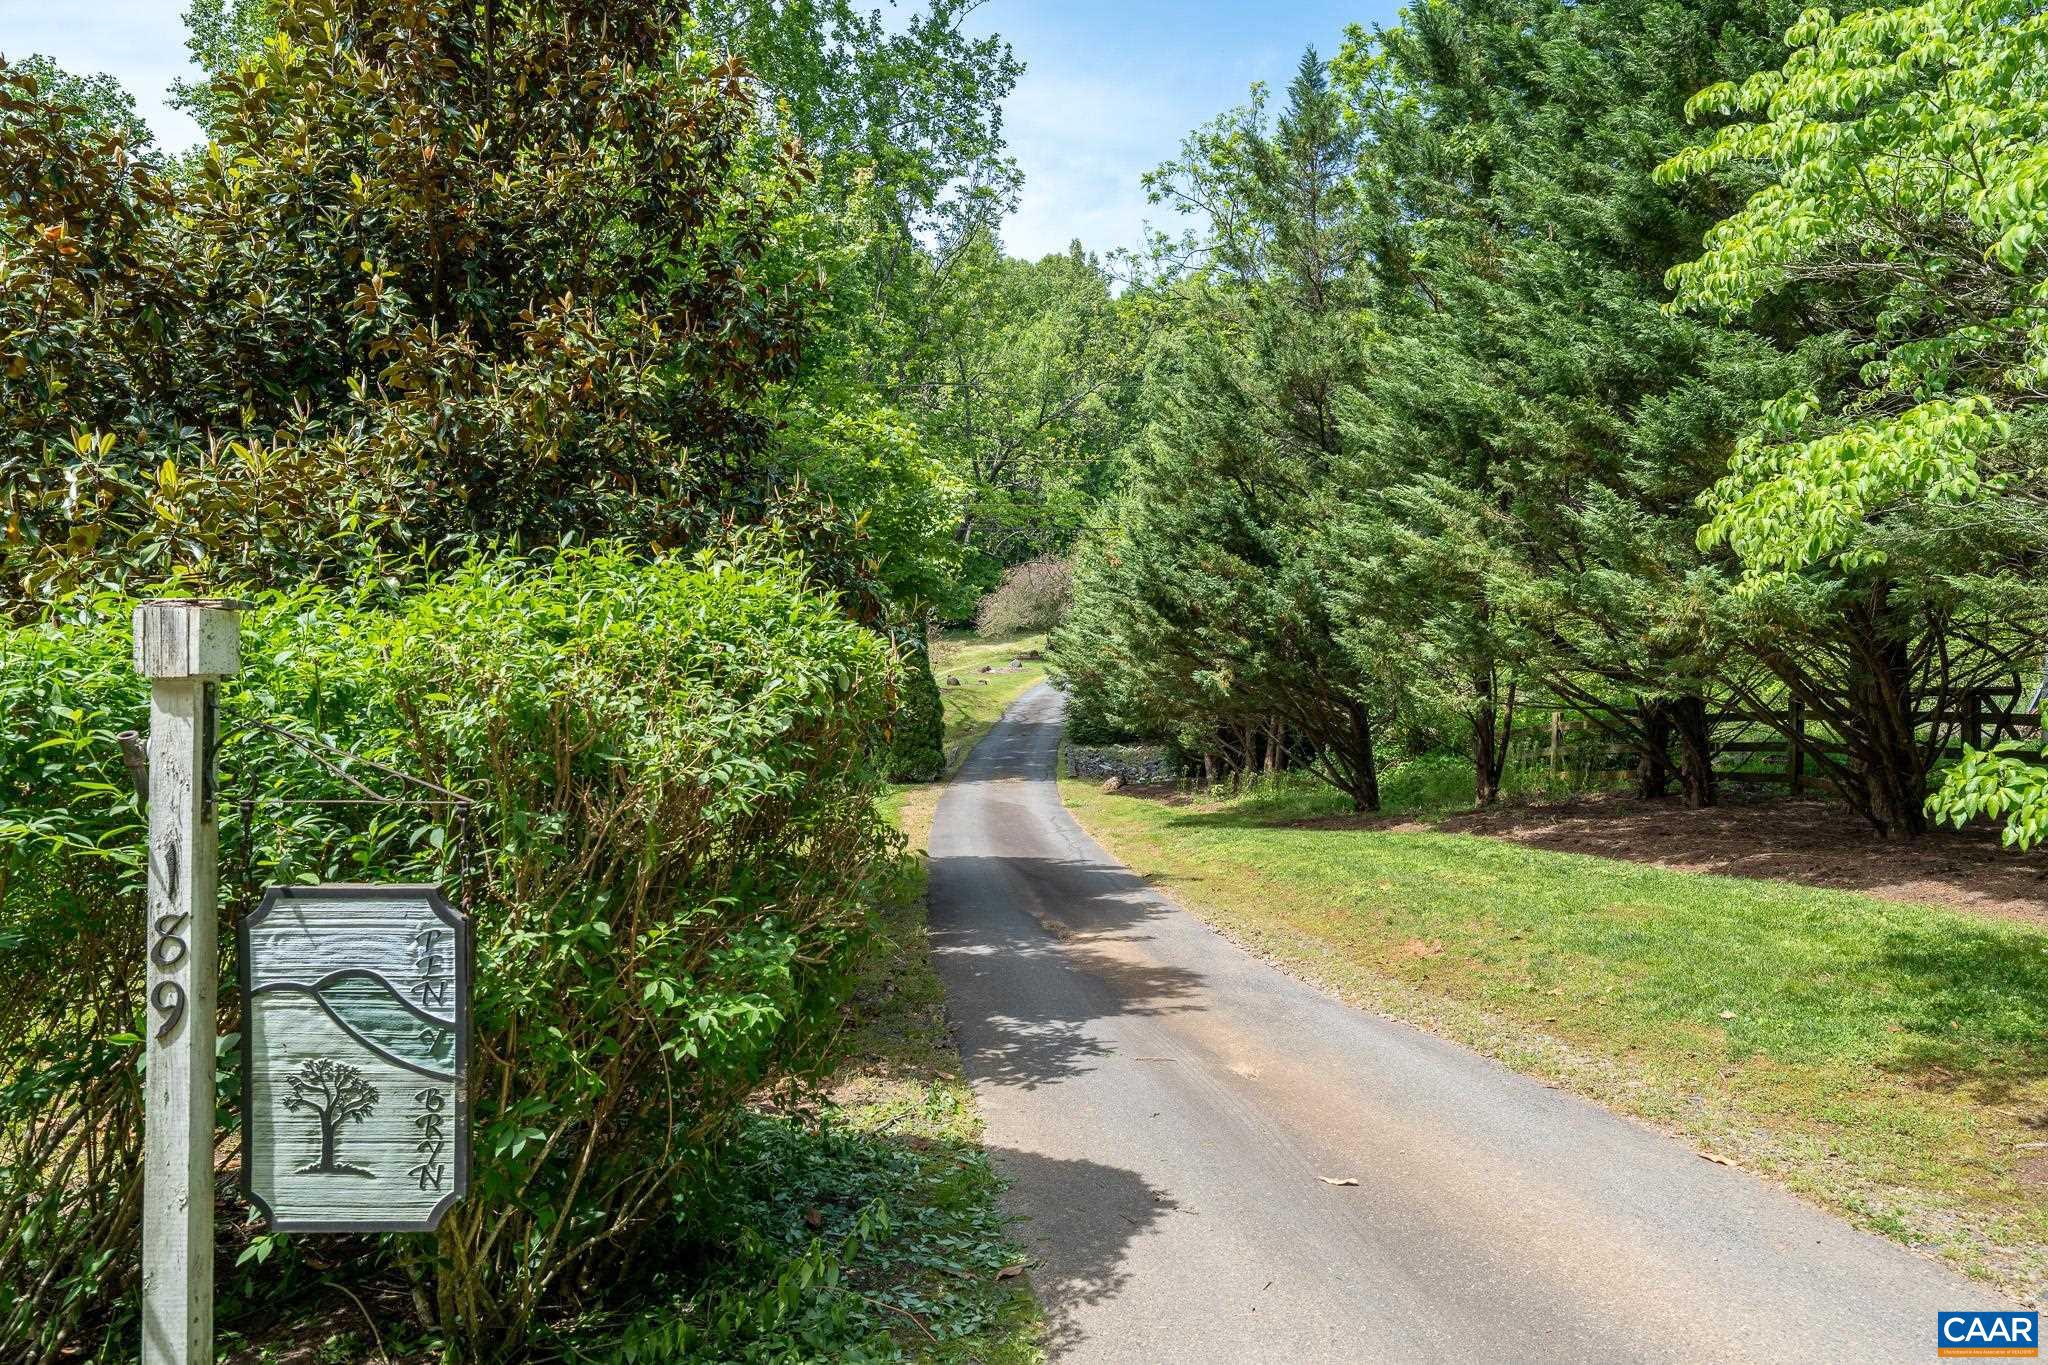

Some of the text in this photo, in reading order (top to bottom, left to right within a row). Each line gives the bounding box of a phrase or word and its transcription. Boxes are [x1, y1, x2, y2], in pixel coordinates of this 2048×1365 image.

[407, 928, 448, 1192] PEN Y BRYN
